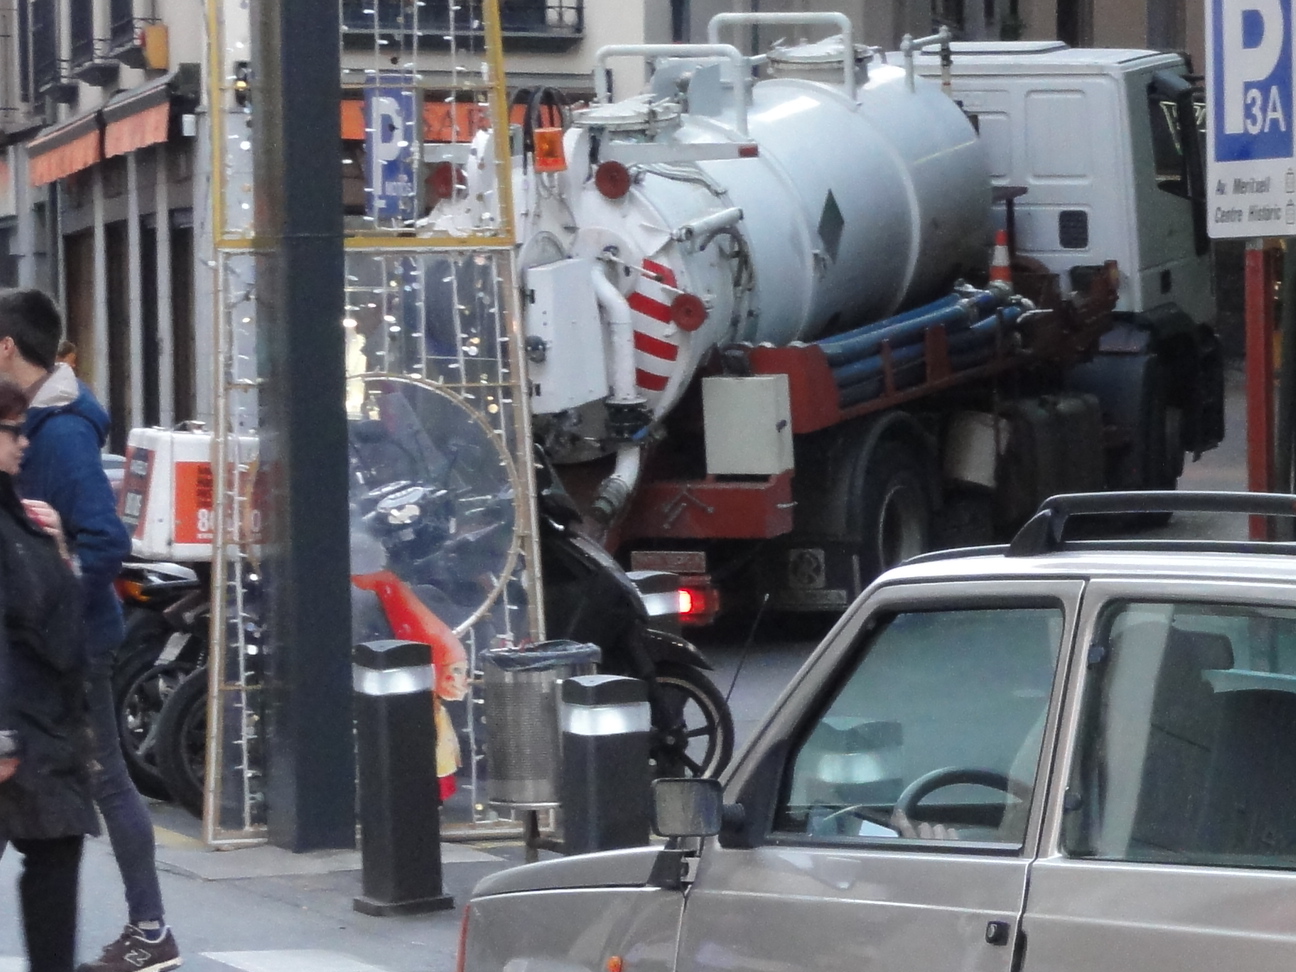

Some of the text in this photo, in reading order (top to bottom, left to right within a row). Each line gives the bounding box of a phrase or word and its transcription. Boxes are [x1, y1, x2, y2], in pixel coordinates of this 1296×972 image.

[1222, 0, 1285, 134] P
[1246, 85, 1287, 135] 3A
[372, 96, 403, 196] P
